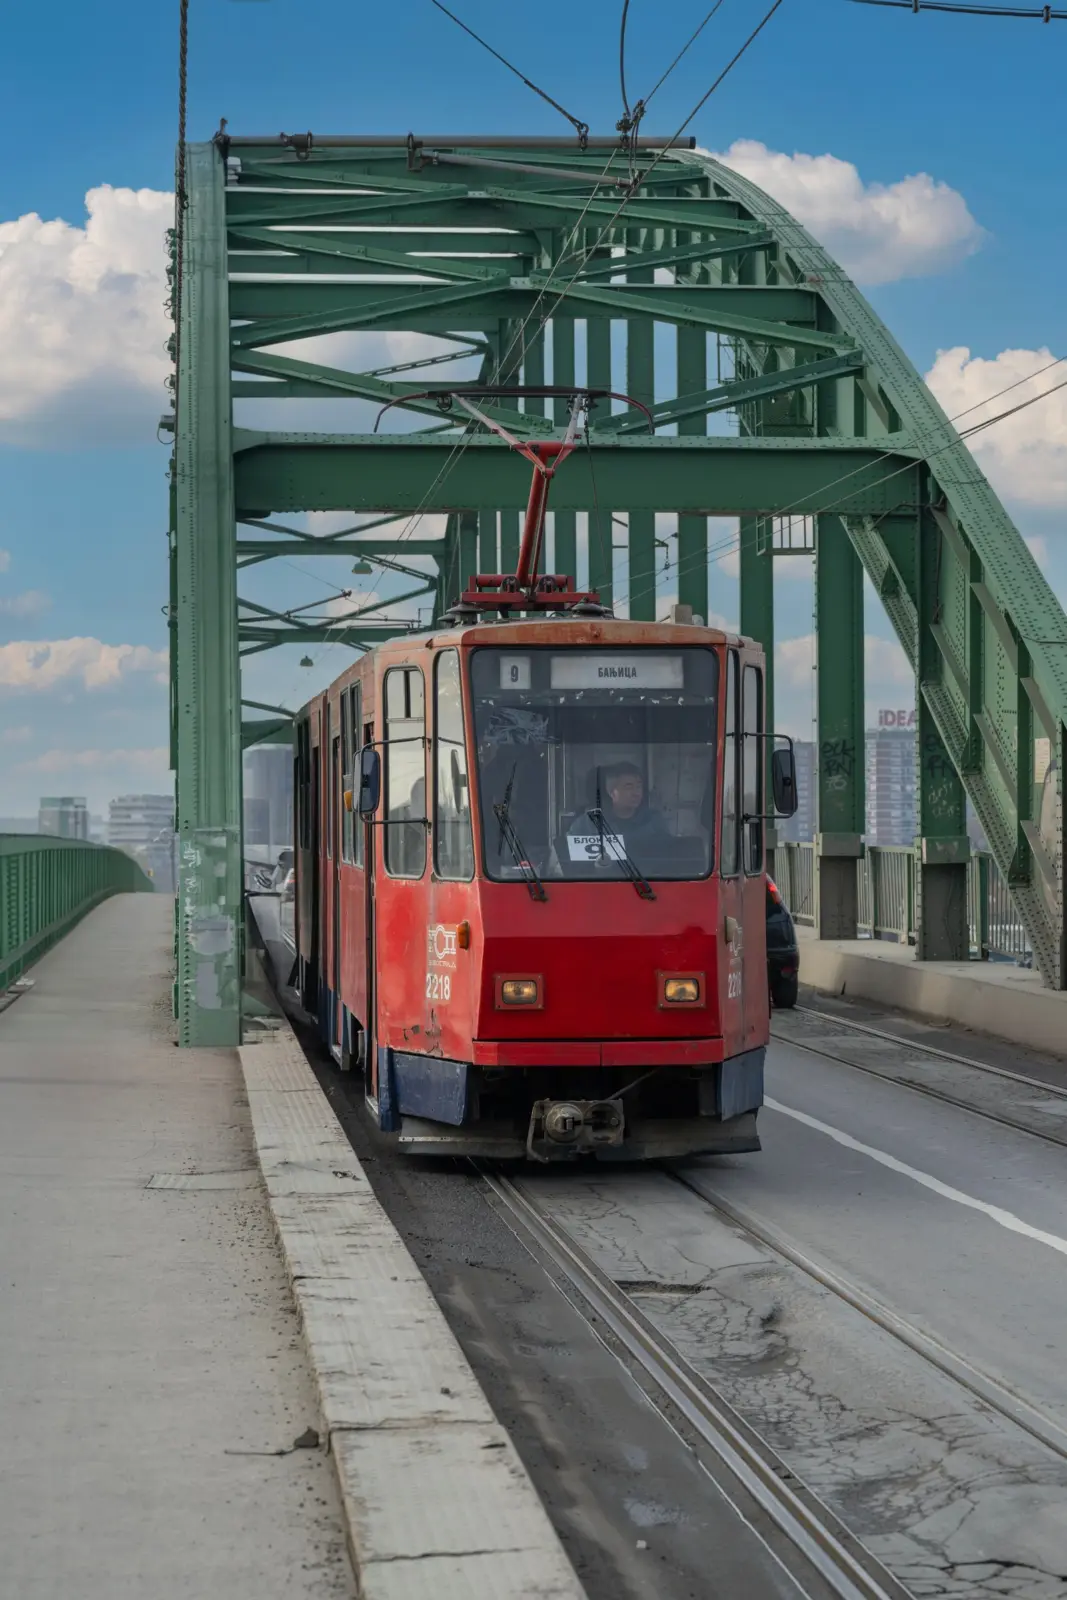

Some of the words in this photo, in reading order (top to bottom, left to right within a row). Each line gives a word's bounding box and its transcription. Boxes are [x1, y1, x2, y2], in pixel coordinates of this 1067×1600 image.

[510, 665, 519, 683] 9
[598, 667, 637, 678] БАЊИЦА
[584, 843, 607, 860] 9
[426, 973, 451, 1000] 2218
